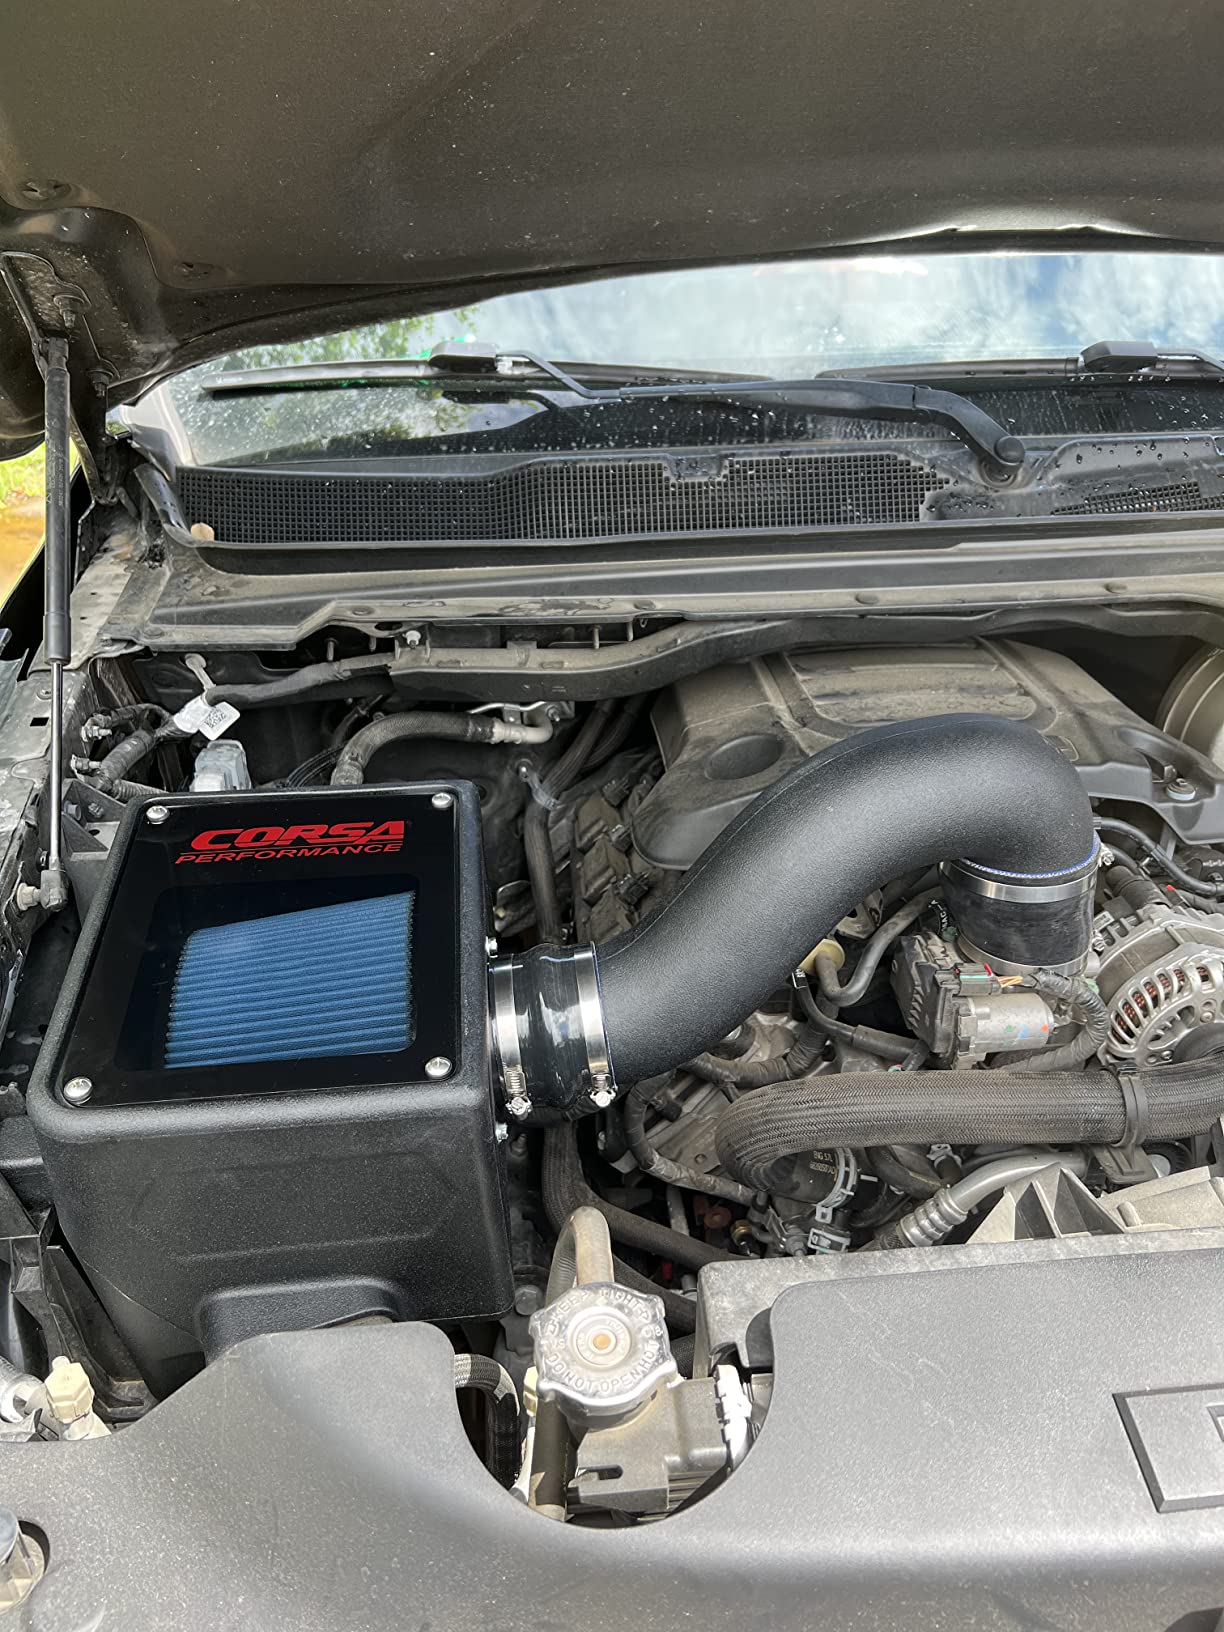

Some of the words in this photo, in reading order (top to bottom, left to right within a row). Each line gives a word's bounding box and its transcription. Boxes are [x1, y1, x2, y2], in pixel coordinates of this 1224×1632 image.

[191, 820, 404, 850] CORSA
[175, 844, 402, 864] PERFORMANCE
[547, 1352, 566, 1374] DO
[563, 1371, 594, 1392] NOT
[599, 1368, 641, 1393] OPEN
[640, 1340, 660, 1370] HOT
